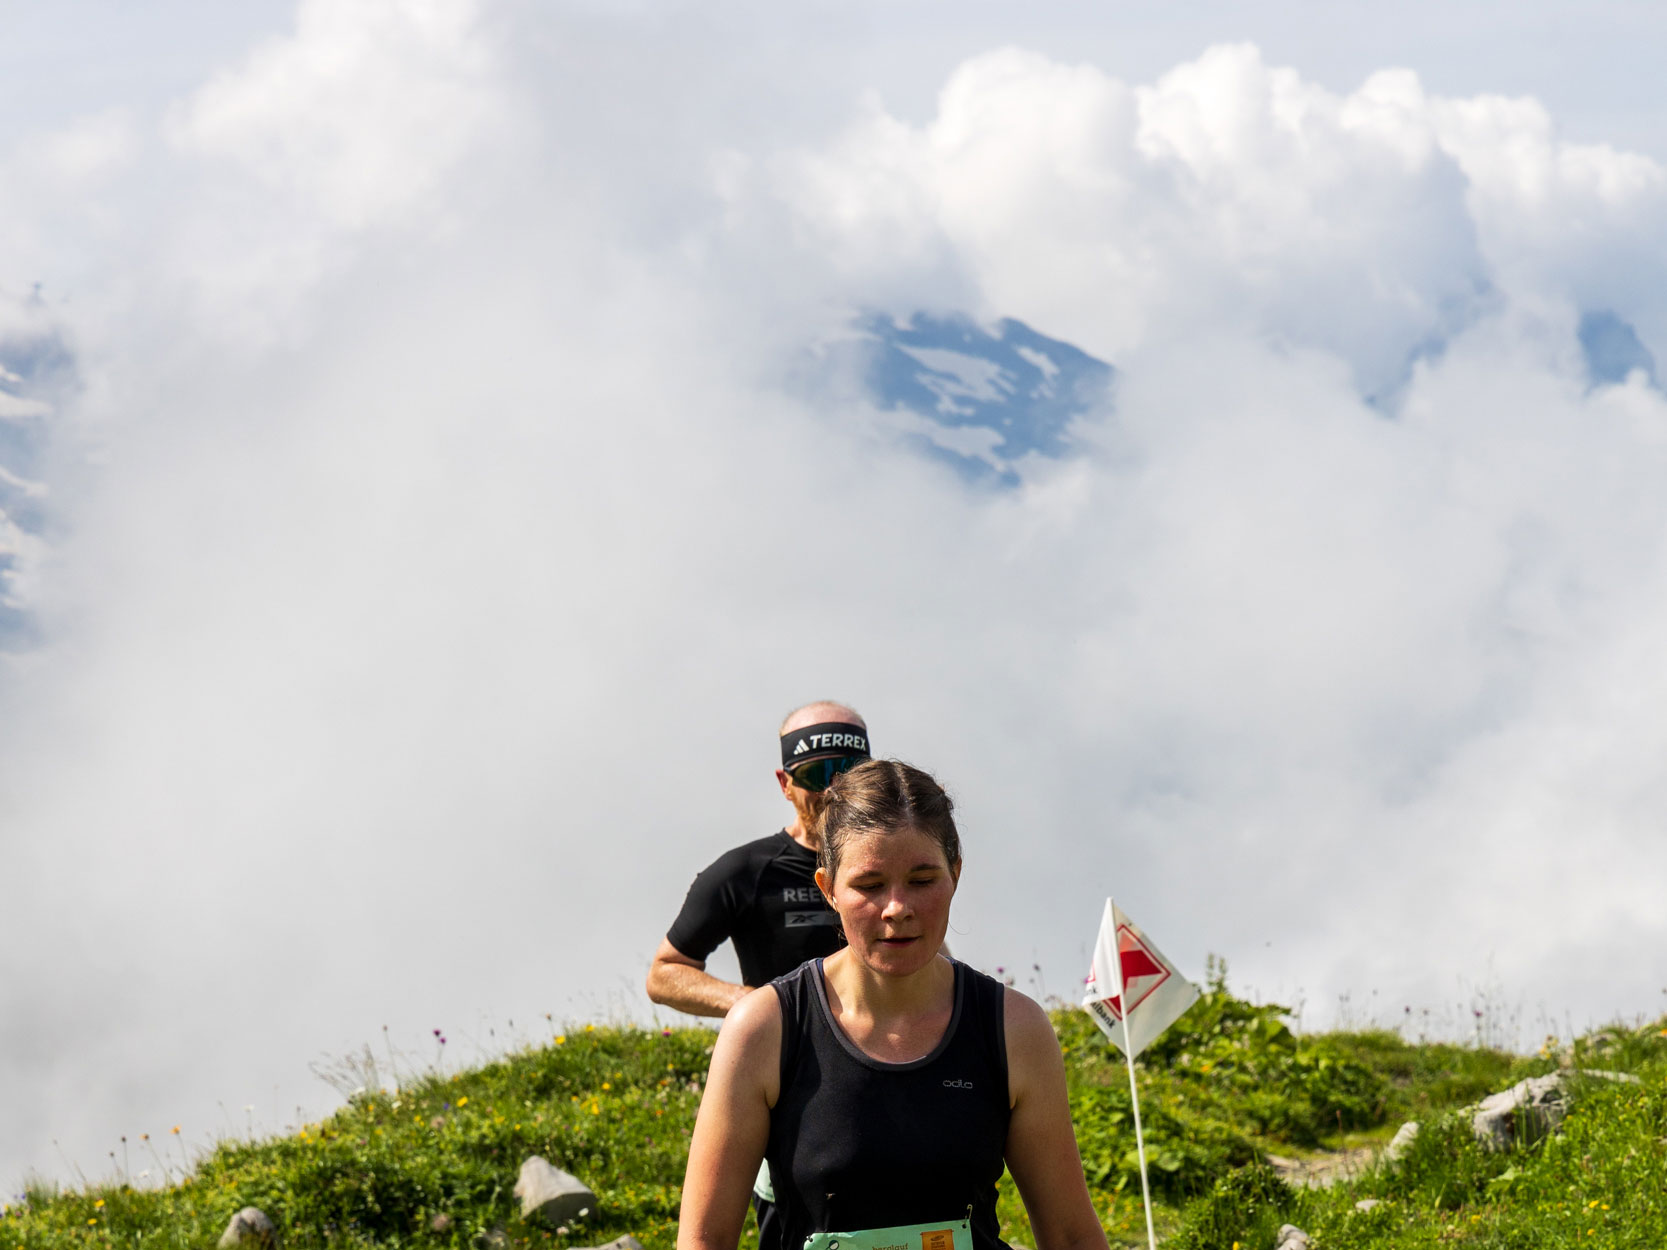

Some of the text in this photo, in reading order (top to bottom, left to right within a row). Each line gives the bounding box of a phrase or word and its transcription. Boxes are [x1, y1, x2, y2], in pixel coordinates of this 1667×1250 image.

[810, 733, 866, 751] TERREX
[783, 887, 823, 902] REE
[942, 1079, 973, 1089] odlo
